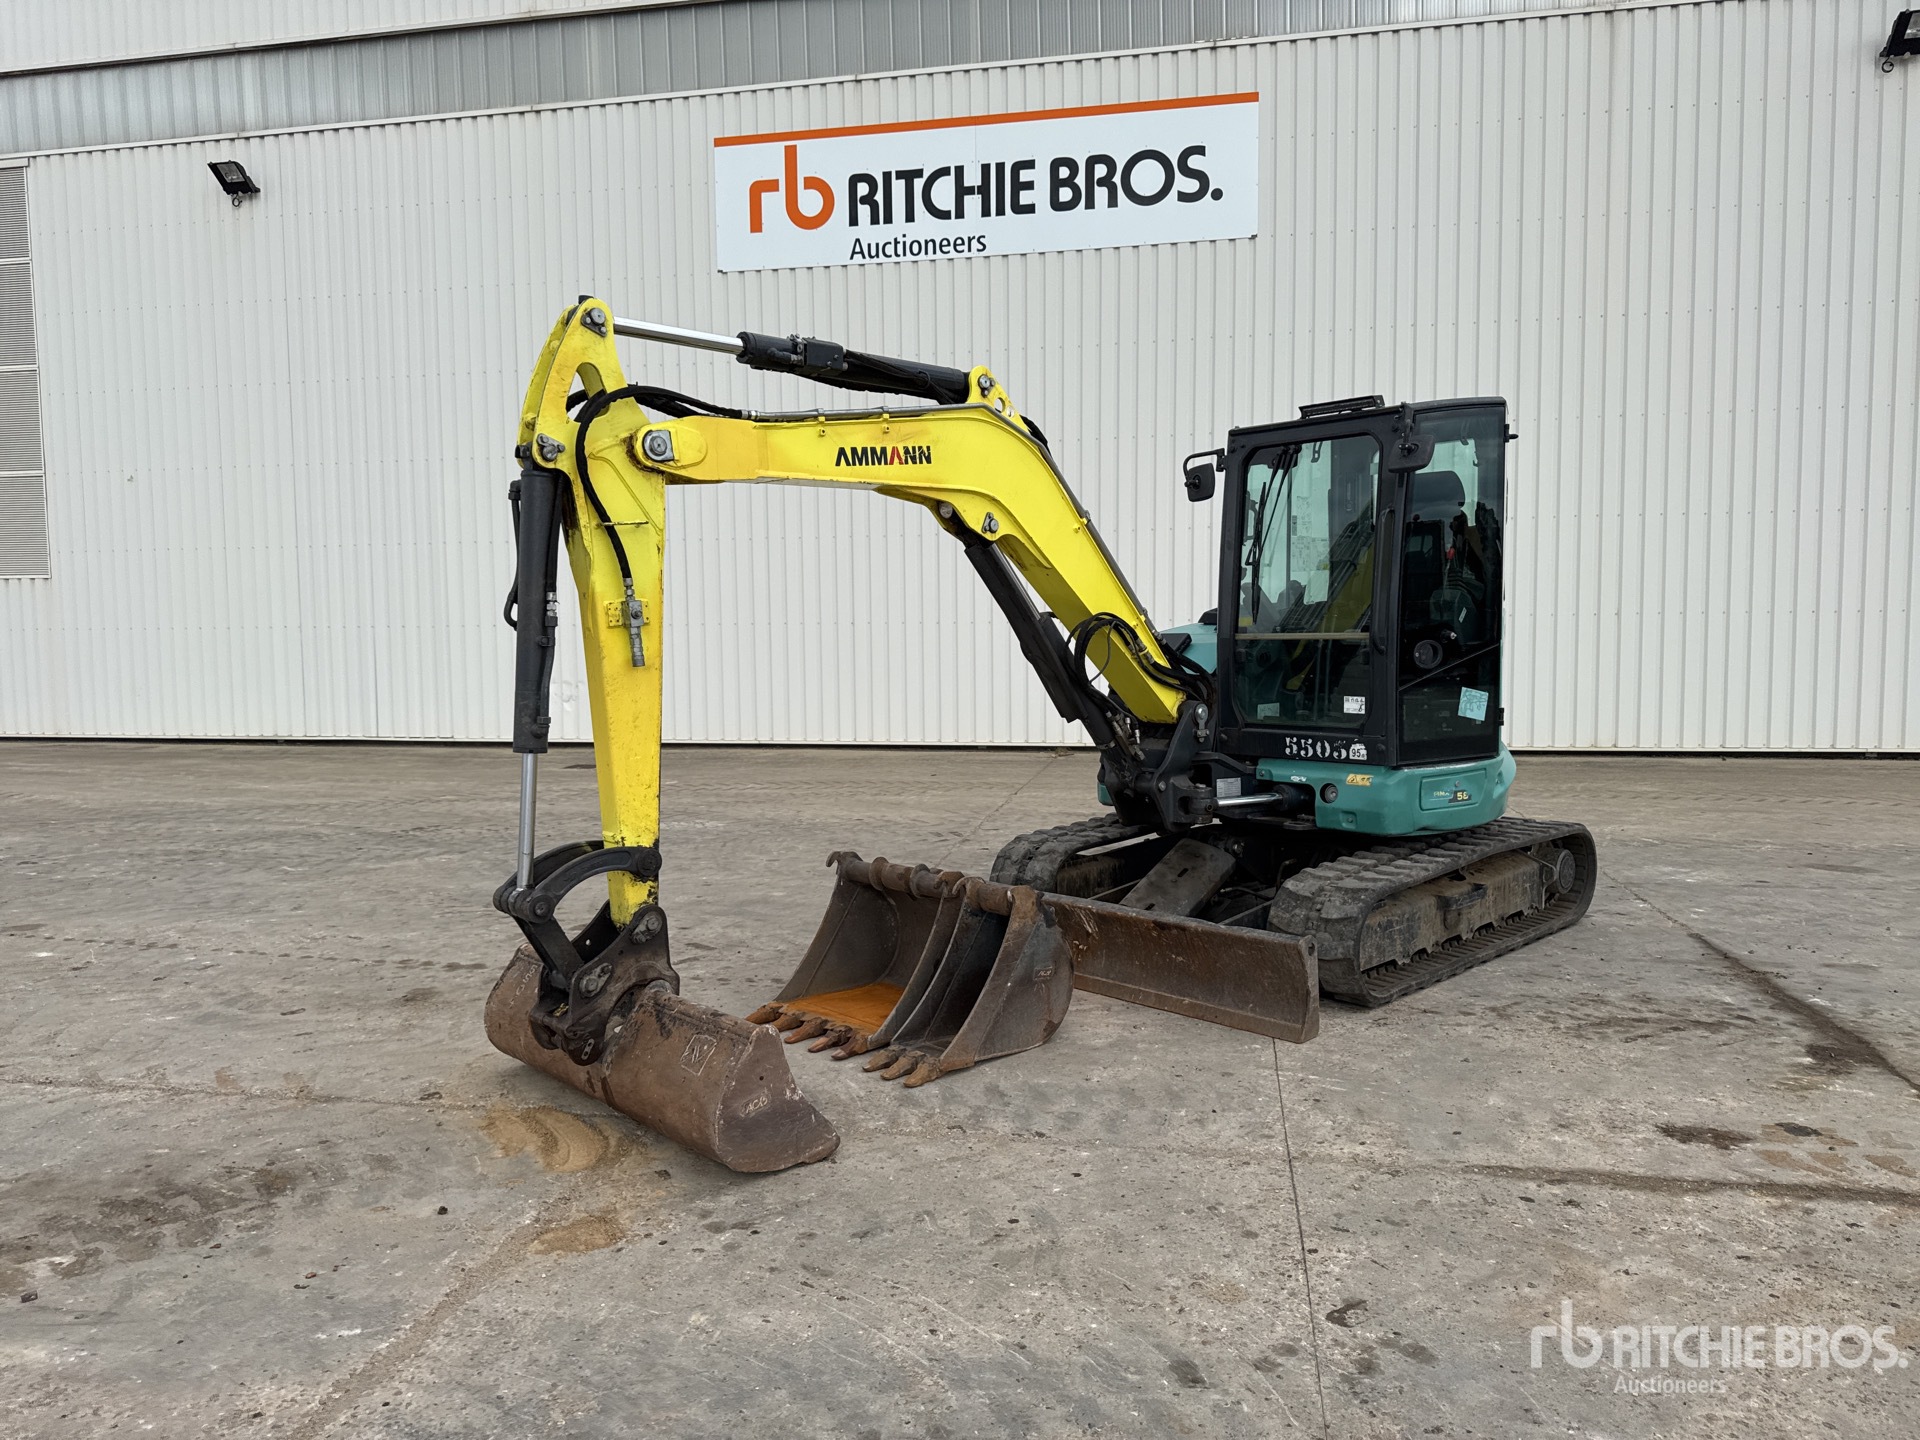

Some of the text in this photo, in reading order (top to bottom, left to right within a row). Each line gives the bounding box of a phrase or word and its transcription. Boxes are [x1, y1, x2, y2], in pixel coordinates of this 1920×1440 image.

[749, 143, 1224, 234] rb RITCHIE BROS.
[848, 233, 988, 262] Auctioneers
[835, 445, 932, 467] AMMANN
